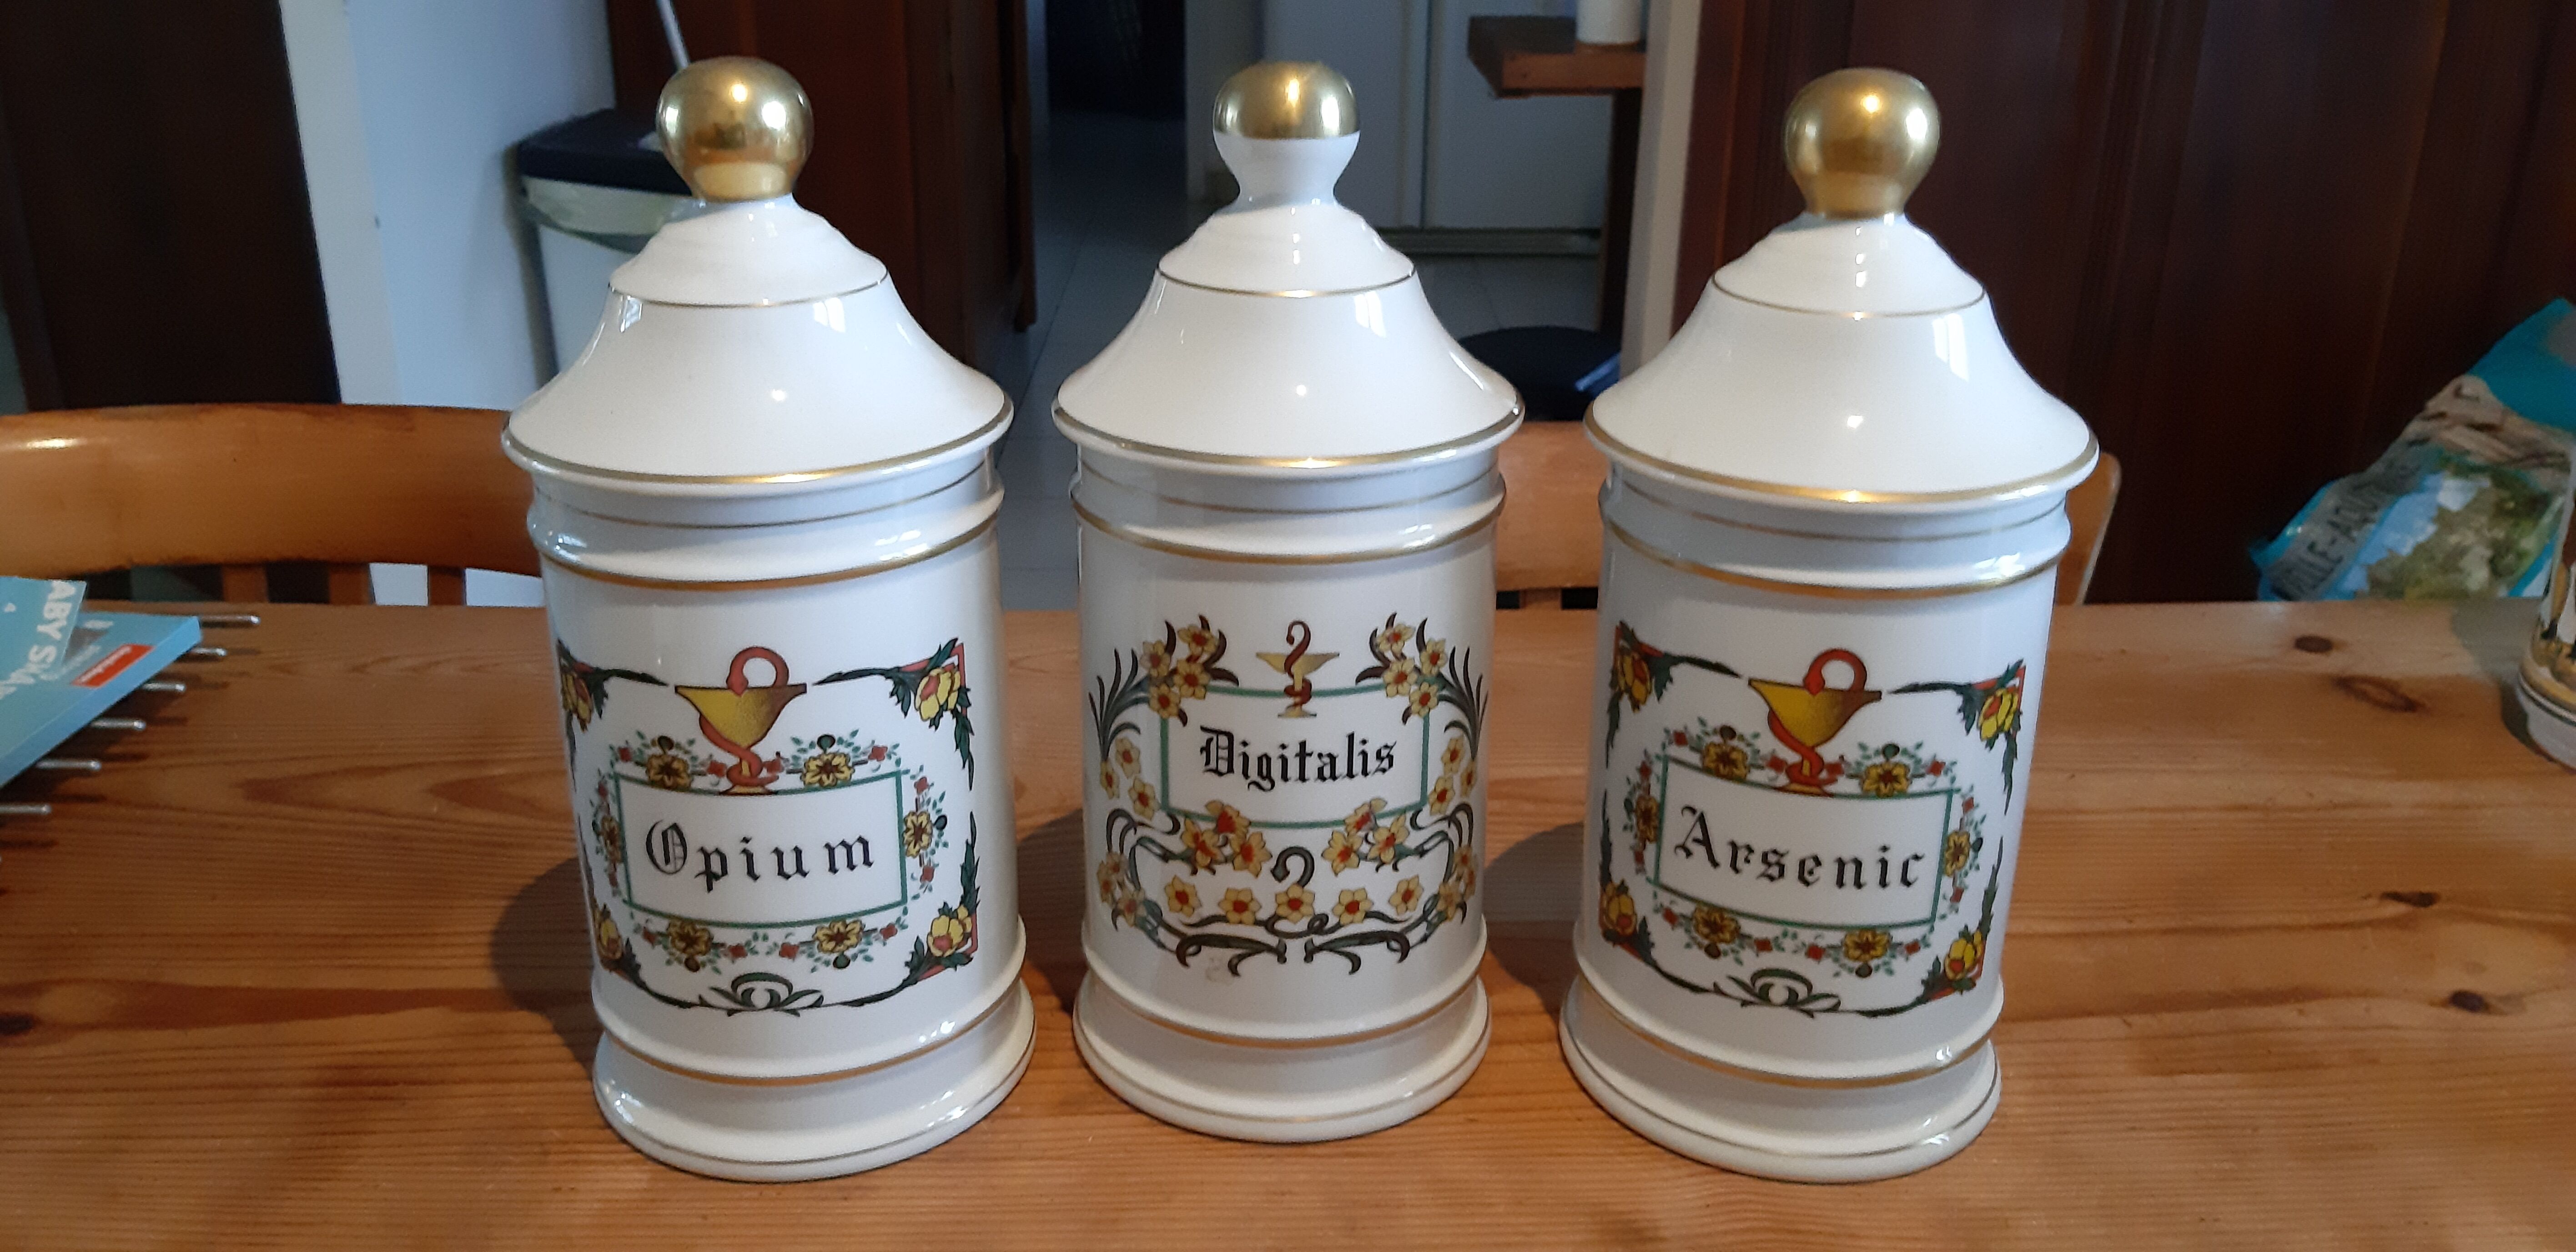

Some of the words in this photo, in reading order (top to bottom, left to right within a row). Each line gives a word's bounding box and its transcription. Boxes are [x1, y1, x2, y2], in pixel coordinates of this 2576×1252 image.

[1200, 725, 1397, 792] Digitalis
[645, 820, 874, 893] Opium
[1674, 805, 1925, 889] Arsenic
